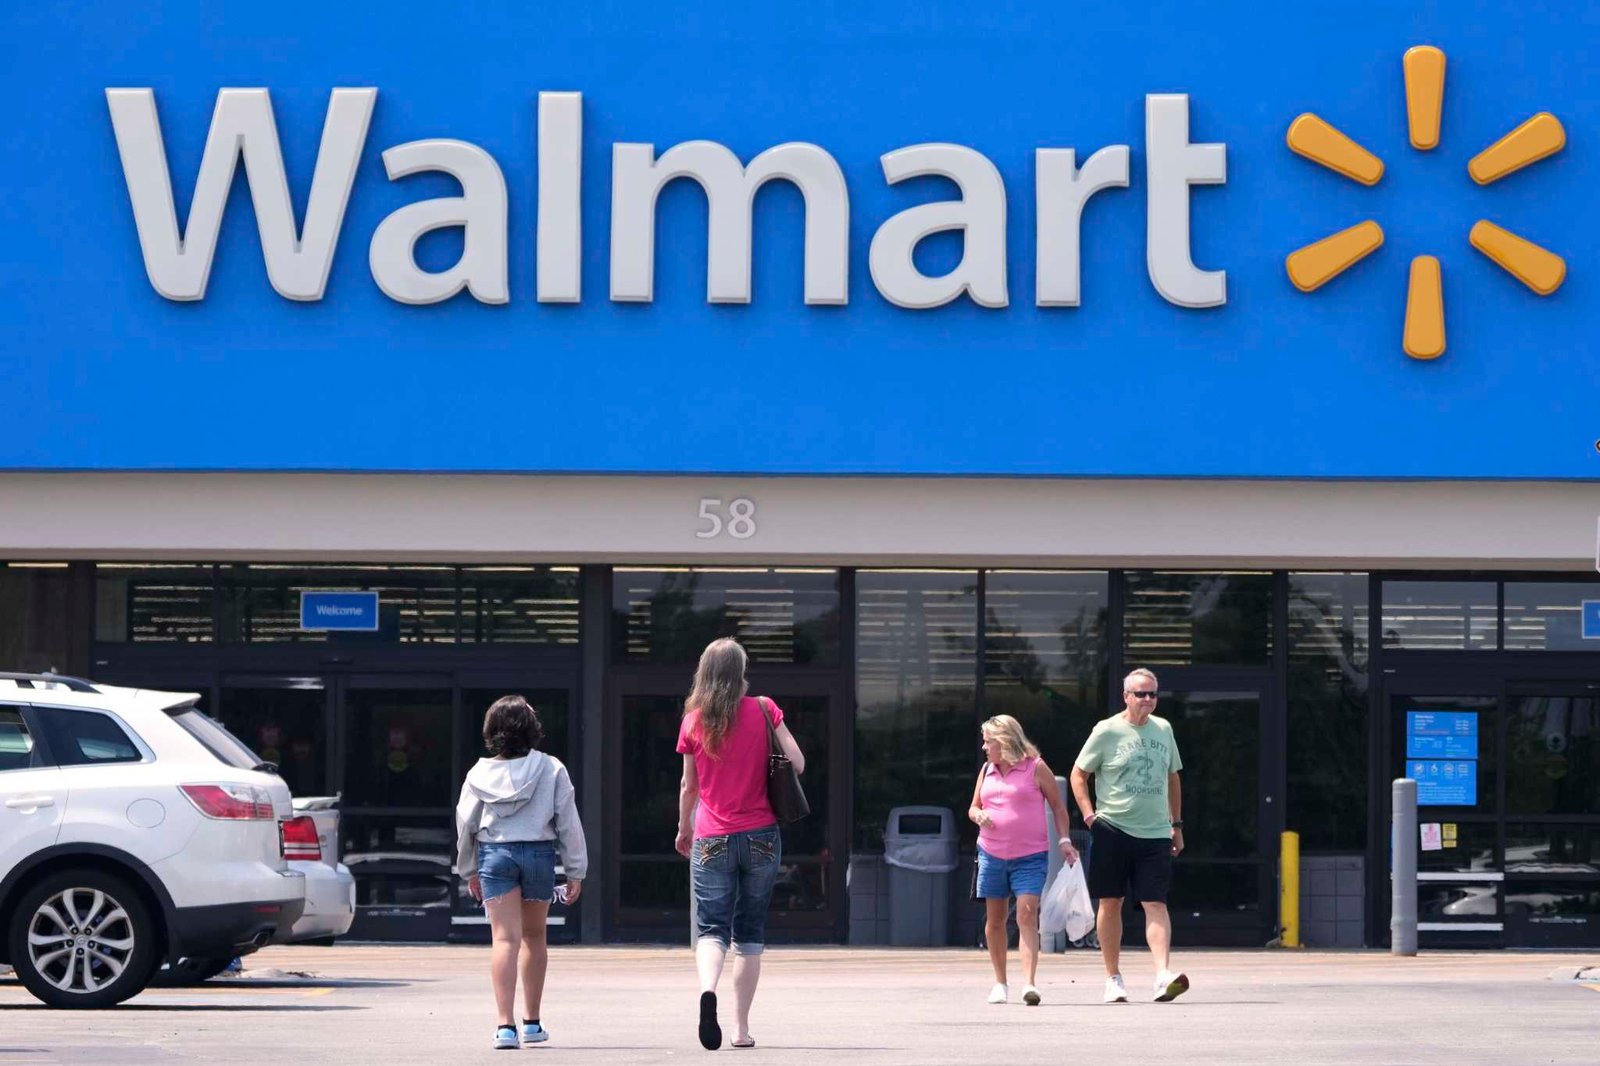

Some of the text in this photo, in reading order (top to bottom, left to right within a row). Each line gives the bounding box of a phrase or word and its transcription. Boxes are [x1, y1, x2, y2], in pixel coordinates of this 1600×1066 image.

[105, 86, 1227, 309] Walmart
[696, 498, 756, 538] 58
[316, 604, 363, 616] Welcome
